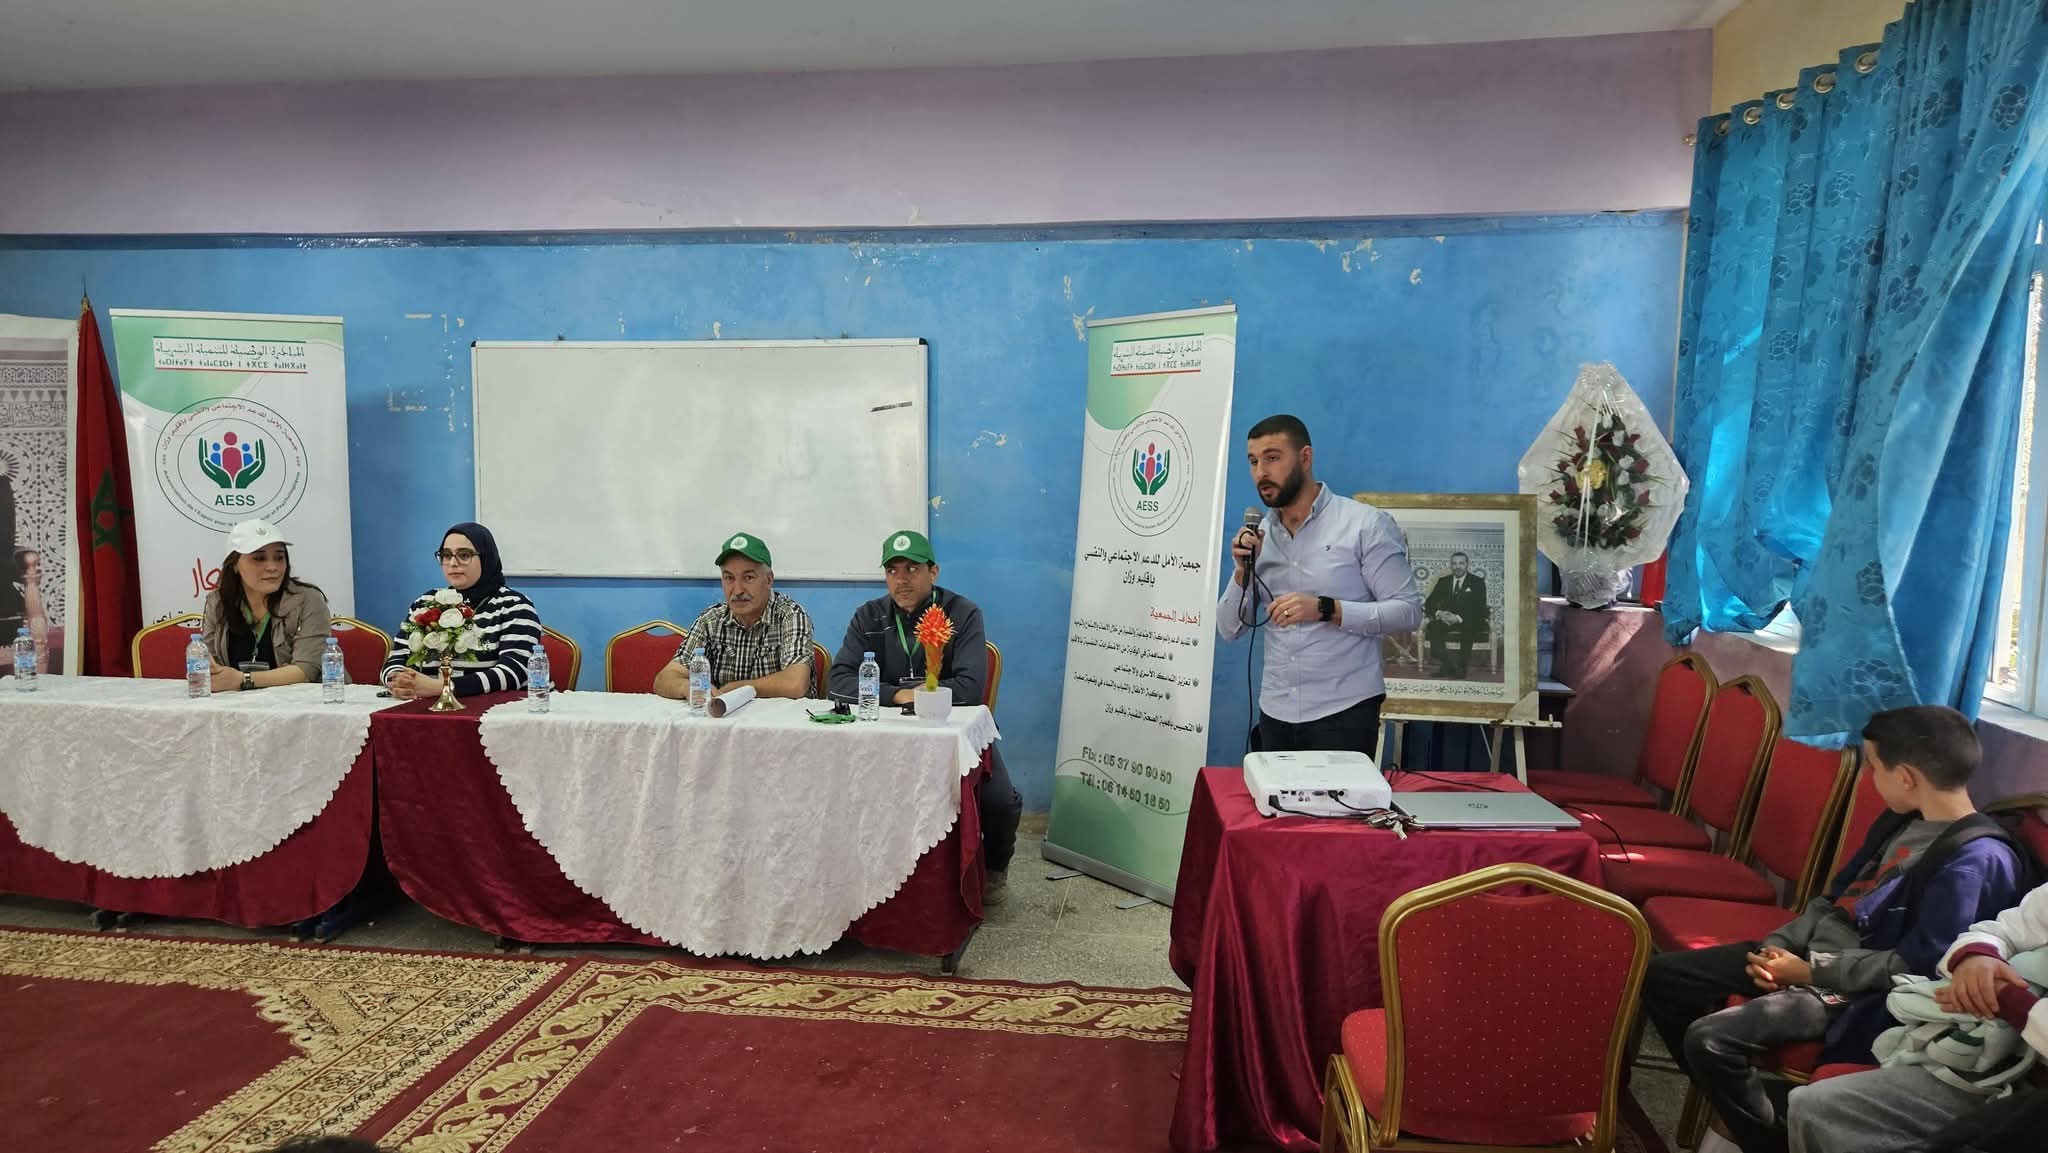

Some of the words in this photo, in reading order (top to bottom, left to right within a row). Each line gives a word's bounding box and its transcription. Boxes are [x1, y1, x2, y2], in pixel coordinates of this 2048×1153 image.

[214, 494, 256, 507] AESS
[1136, 500, 1159, 512] AESS
[1083, 545, 1108, 562] والنفسي
[1108, 549, 1141, 565] الاجتماعي
[1141, 553, 1161, 565] للدعم
[1178, 555, 1201, 574] جمعية
[1149, 606, 1177, 623] الجمعية
[1103, 753, 1116, 767] 05
[1117, 757, 1130, 771] 37
[1116, 783, 1128, 798] 14
